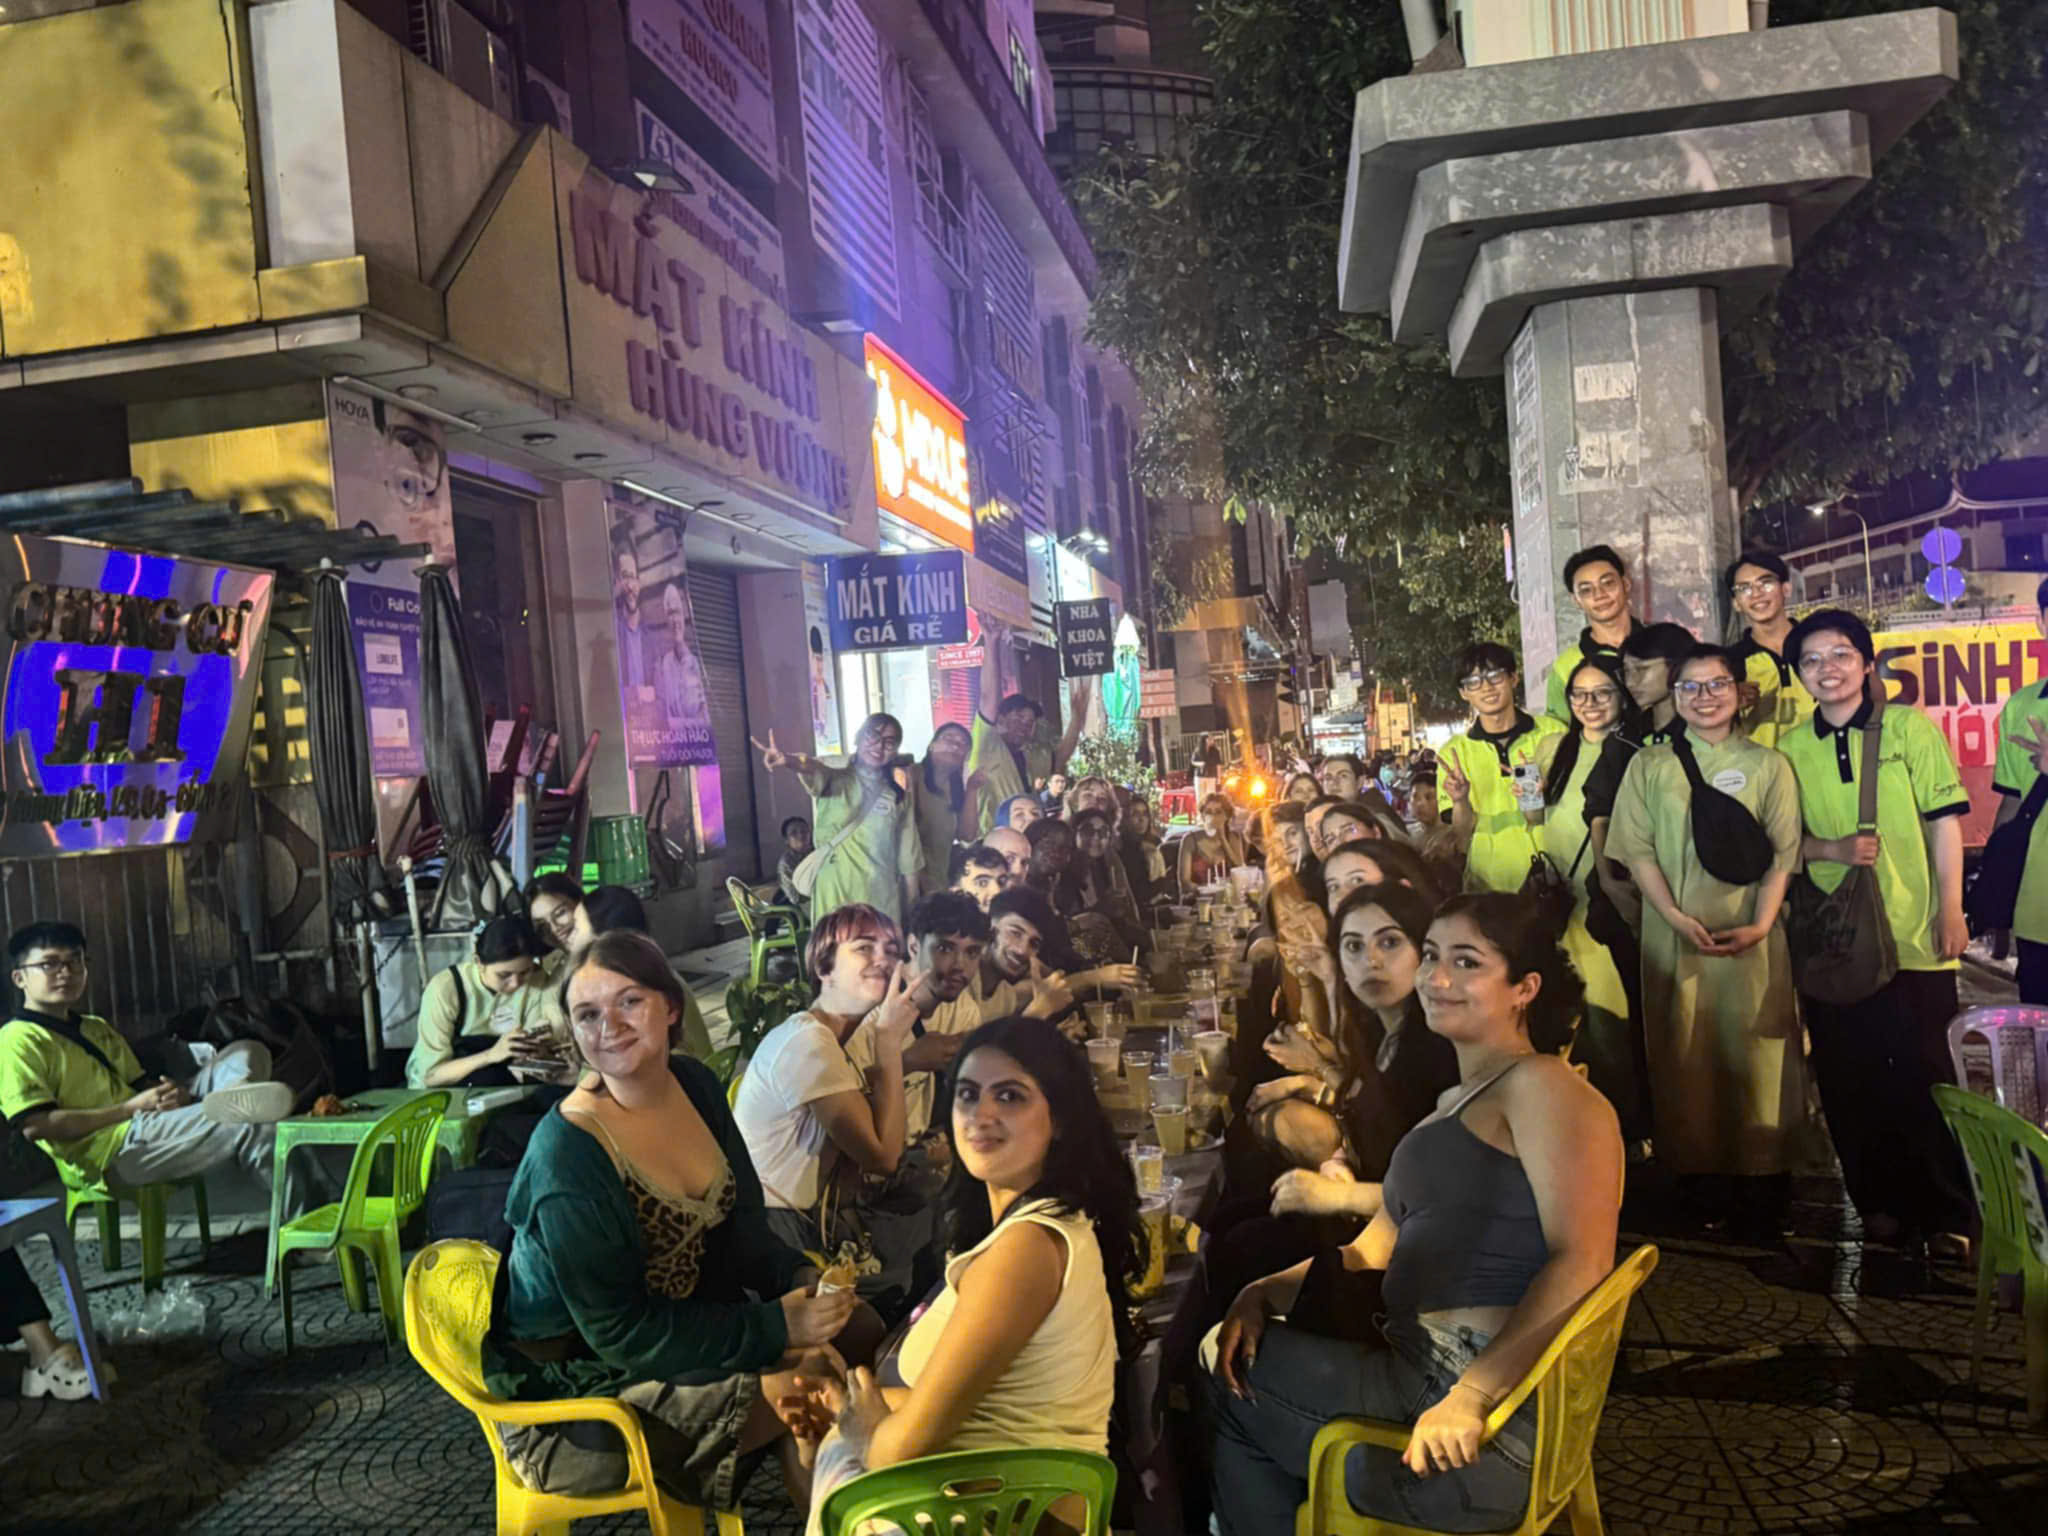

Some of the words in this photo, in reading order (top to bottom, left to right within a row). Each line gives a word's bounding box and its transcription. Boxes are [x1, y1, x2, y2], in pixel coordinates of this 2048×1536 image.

[836, 562, 889, 621] MẮT
[896, 563, 957, 616] KÍNH
[1069, 604, 1100, 620] NHA
[853, 619, 898, 644] GIÁ
[906, 614, 944, 640] RẺ
[1066, 627, 1107, 645] KHOA
[1071, 648, 1105, 670] VIỆT
